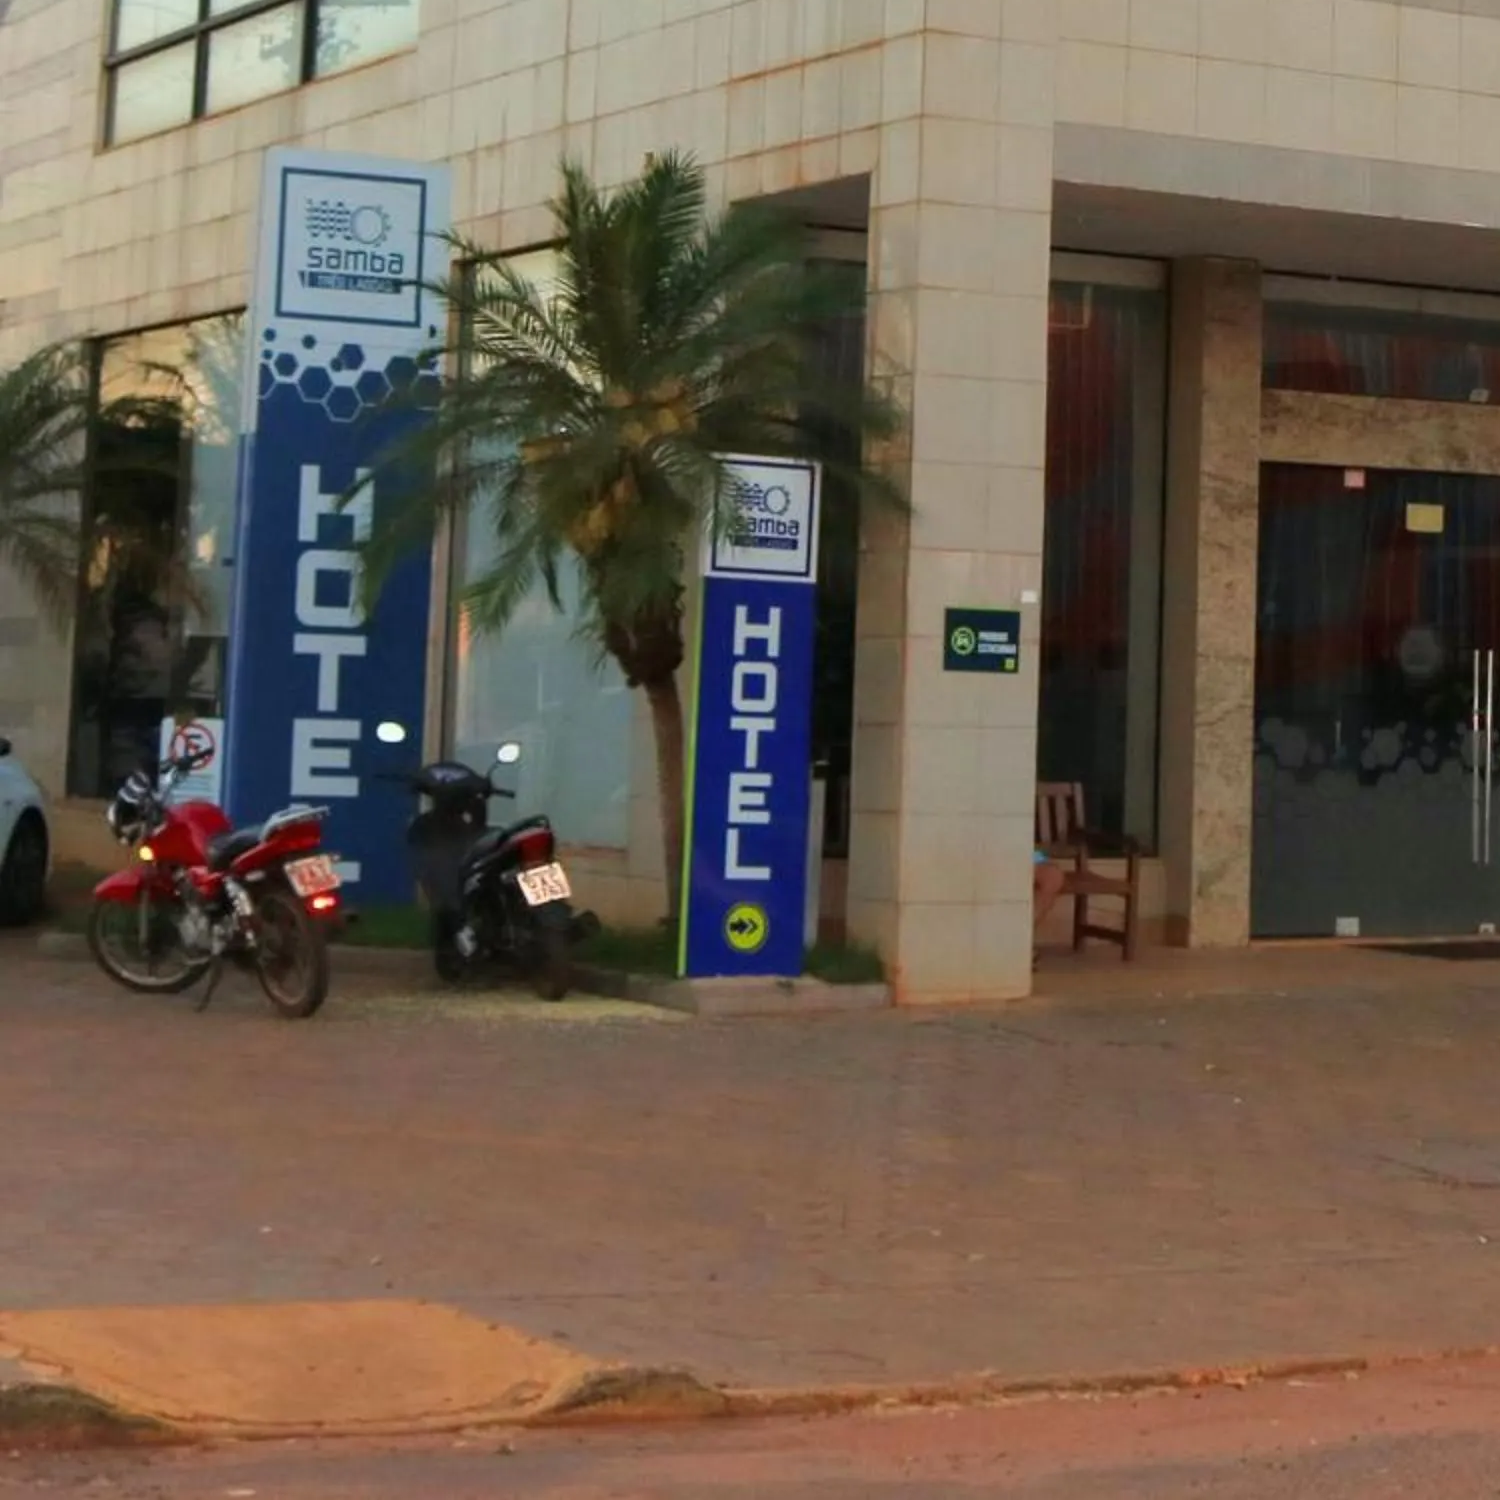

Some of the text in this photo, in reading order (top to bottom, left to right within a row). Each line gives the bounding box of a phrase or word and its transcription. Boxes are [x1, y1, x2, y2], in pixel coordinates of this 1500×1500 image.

[307, 246, 404, 275] samba
[290, 464, 375, 883] HOTE
[724, 605, 782, 881] HOTEL
